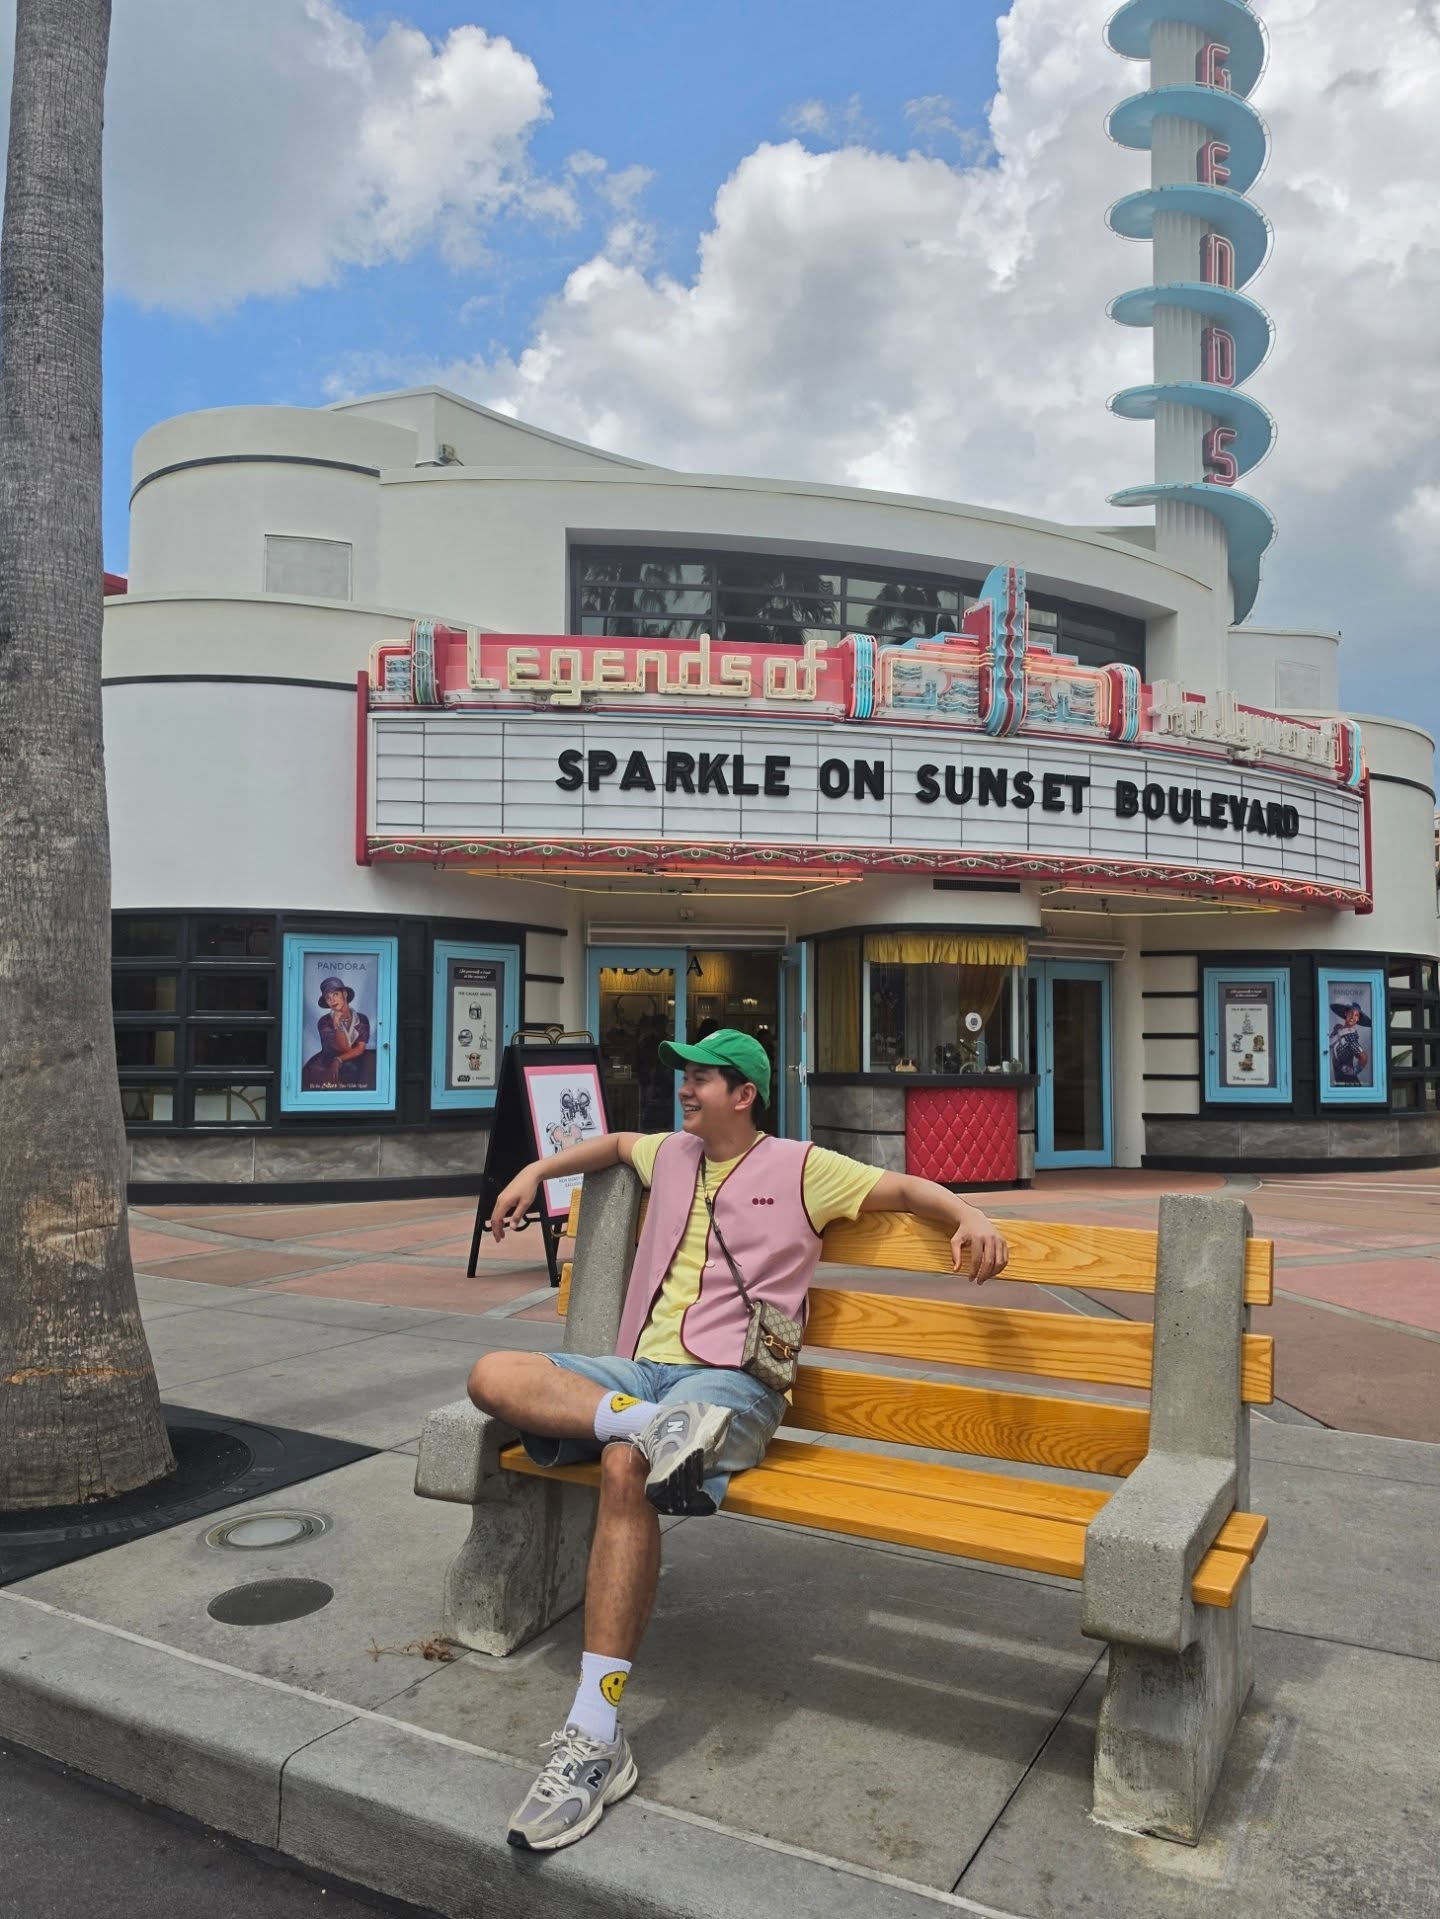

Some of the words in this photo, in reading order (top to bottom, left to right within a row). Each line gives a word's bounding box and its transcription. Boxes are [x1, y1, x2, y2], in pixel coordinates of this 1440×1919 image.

[764, 639, 828, 701] of
[555, 748, 791, 797] SPARKLE
[819, 758, 885, 801] ON
[915, 763, 1091, 814] SUNSET
[1115, 779, 1300, 838] BOULEVARD
[317, 961, 367, 971] PANDORA
[667, 1420, 683, 1433] N
[585, 1766, 604, 1790] N
